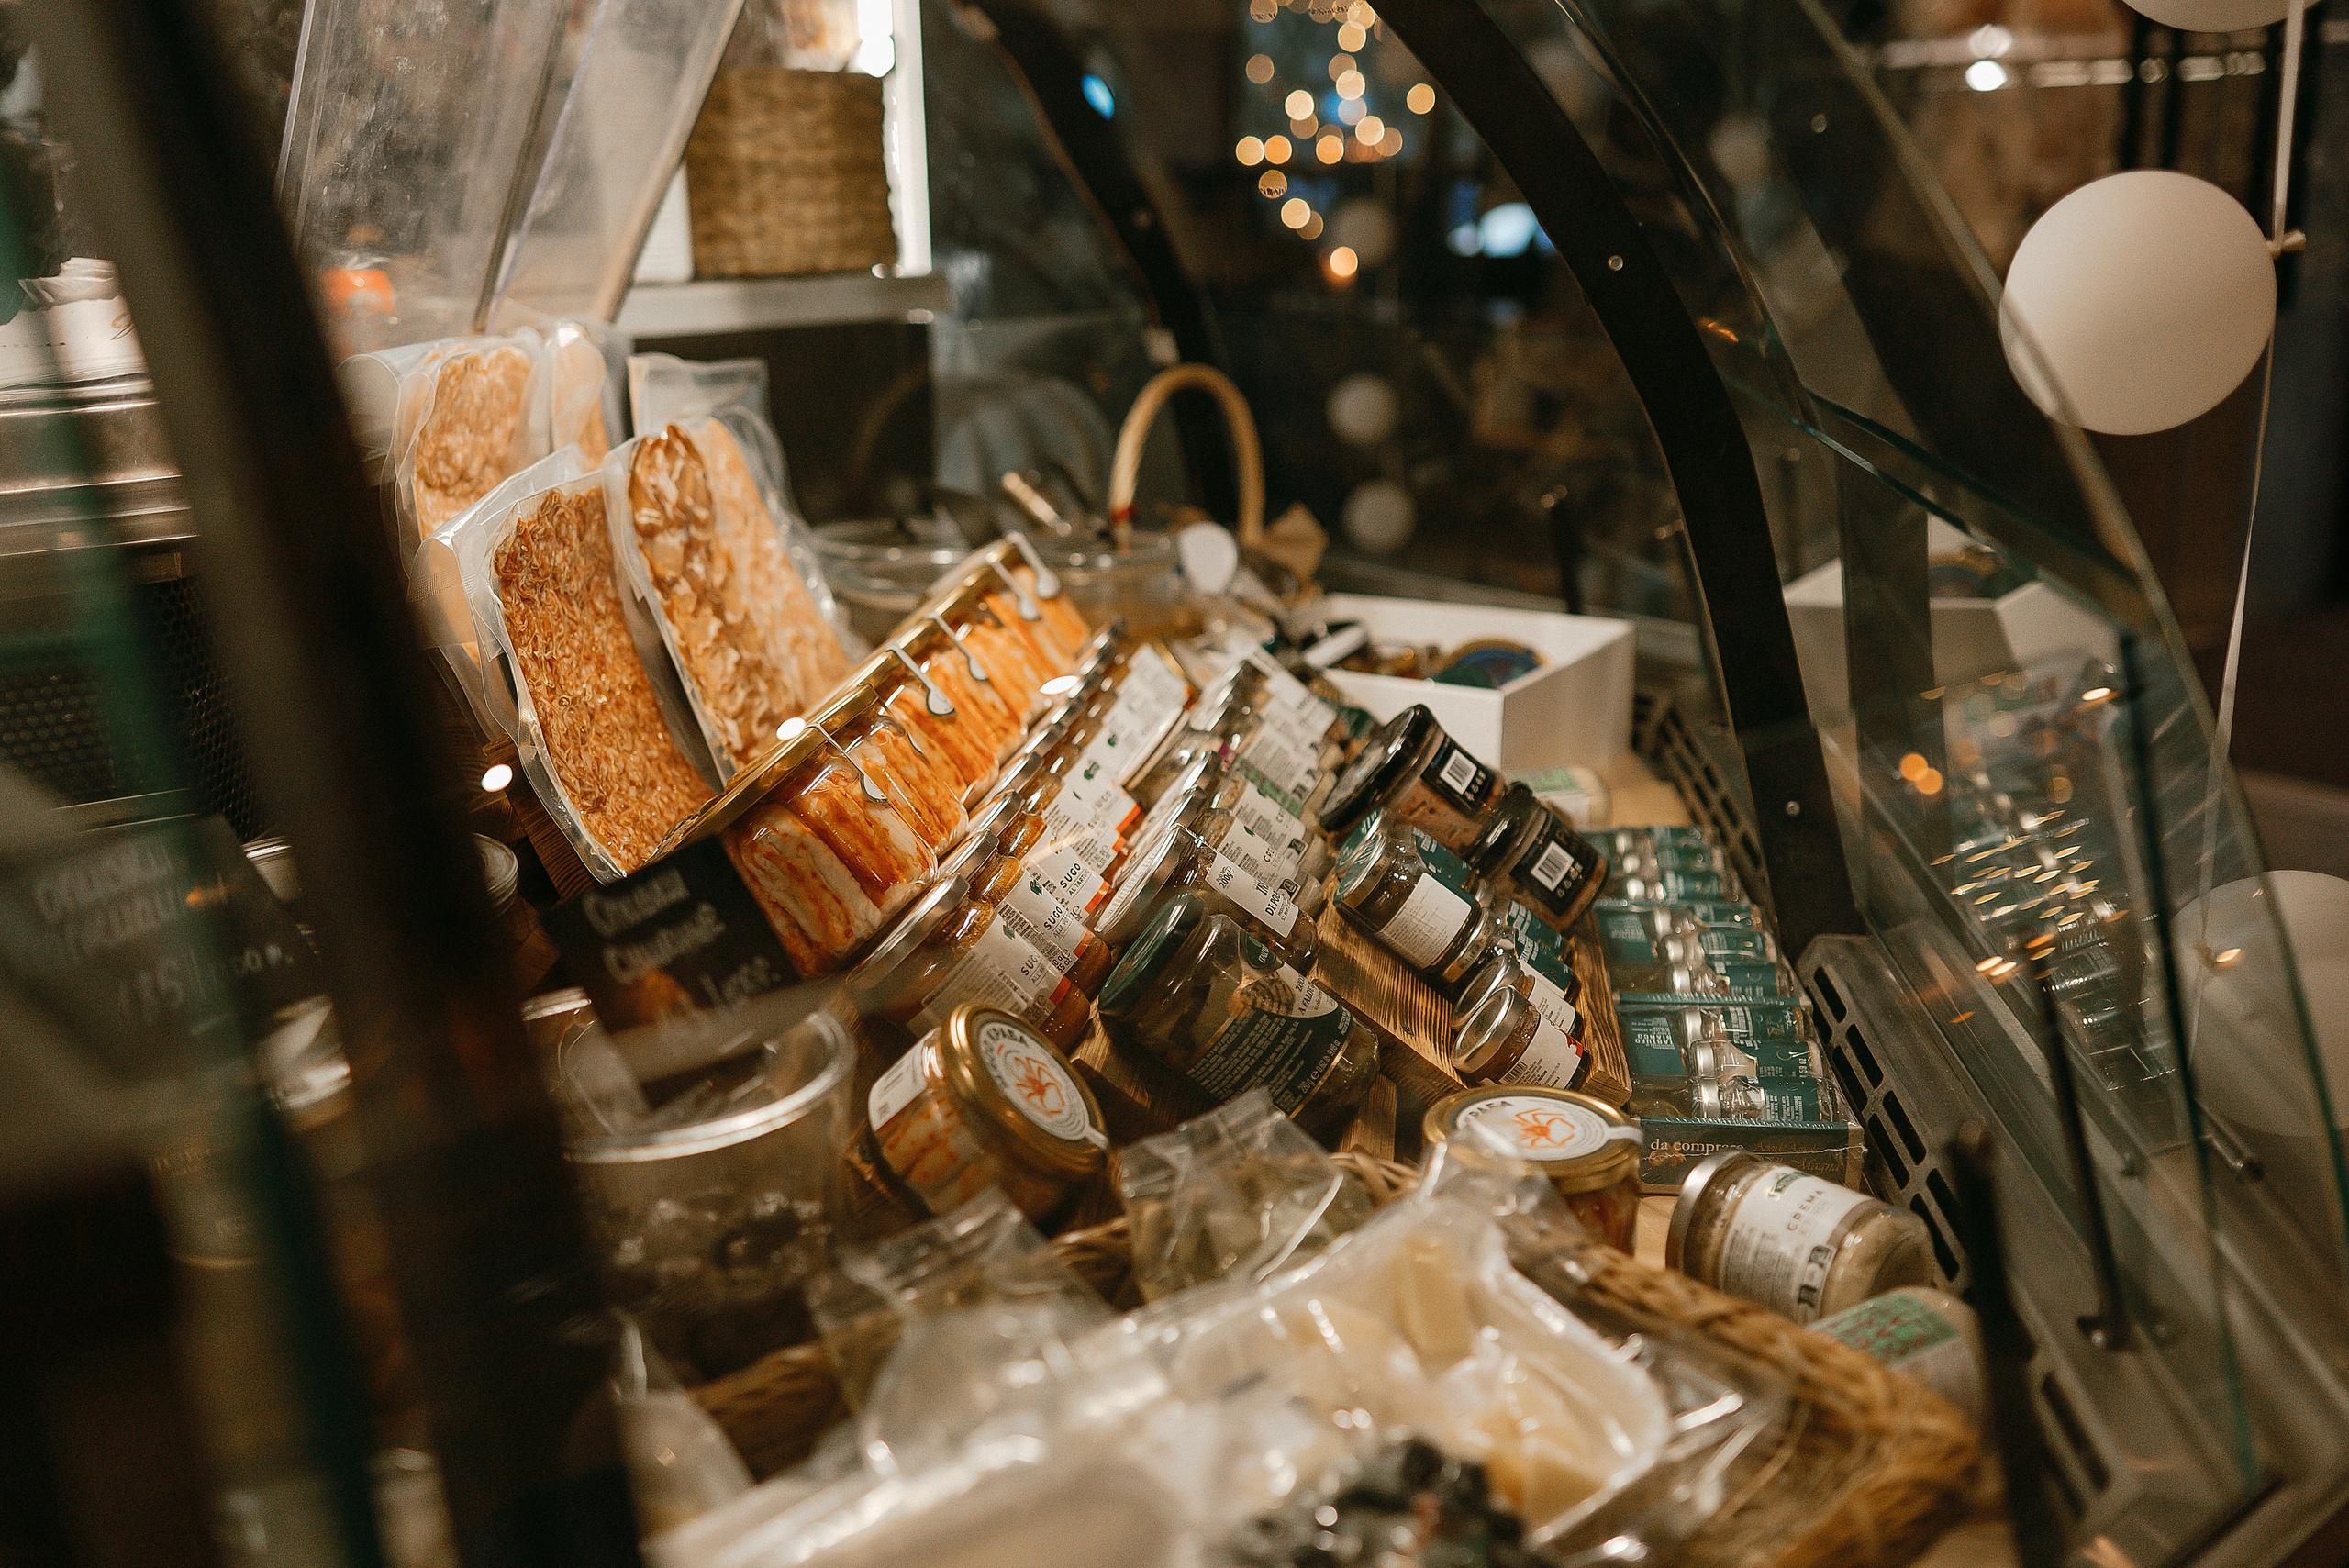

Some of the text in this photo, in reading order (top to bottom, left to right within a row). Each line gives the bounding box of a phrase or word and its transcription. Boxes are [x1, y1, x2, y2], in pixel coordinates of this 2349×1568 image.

[1059, 862, 1081, 889] SUGO
[1068, 887, 1076, 896] AL
[1043, 906, 1063, 930] SUGO
[1298, 1006, 1307, 1015] A
[1651, 1139, 1668, 1150] da
[1674, 1140, 1743, 1155] compr
